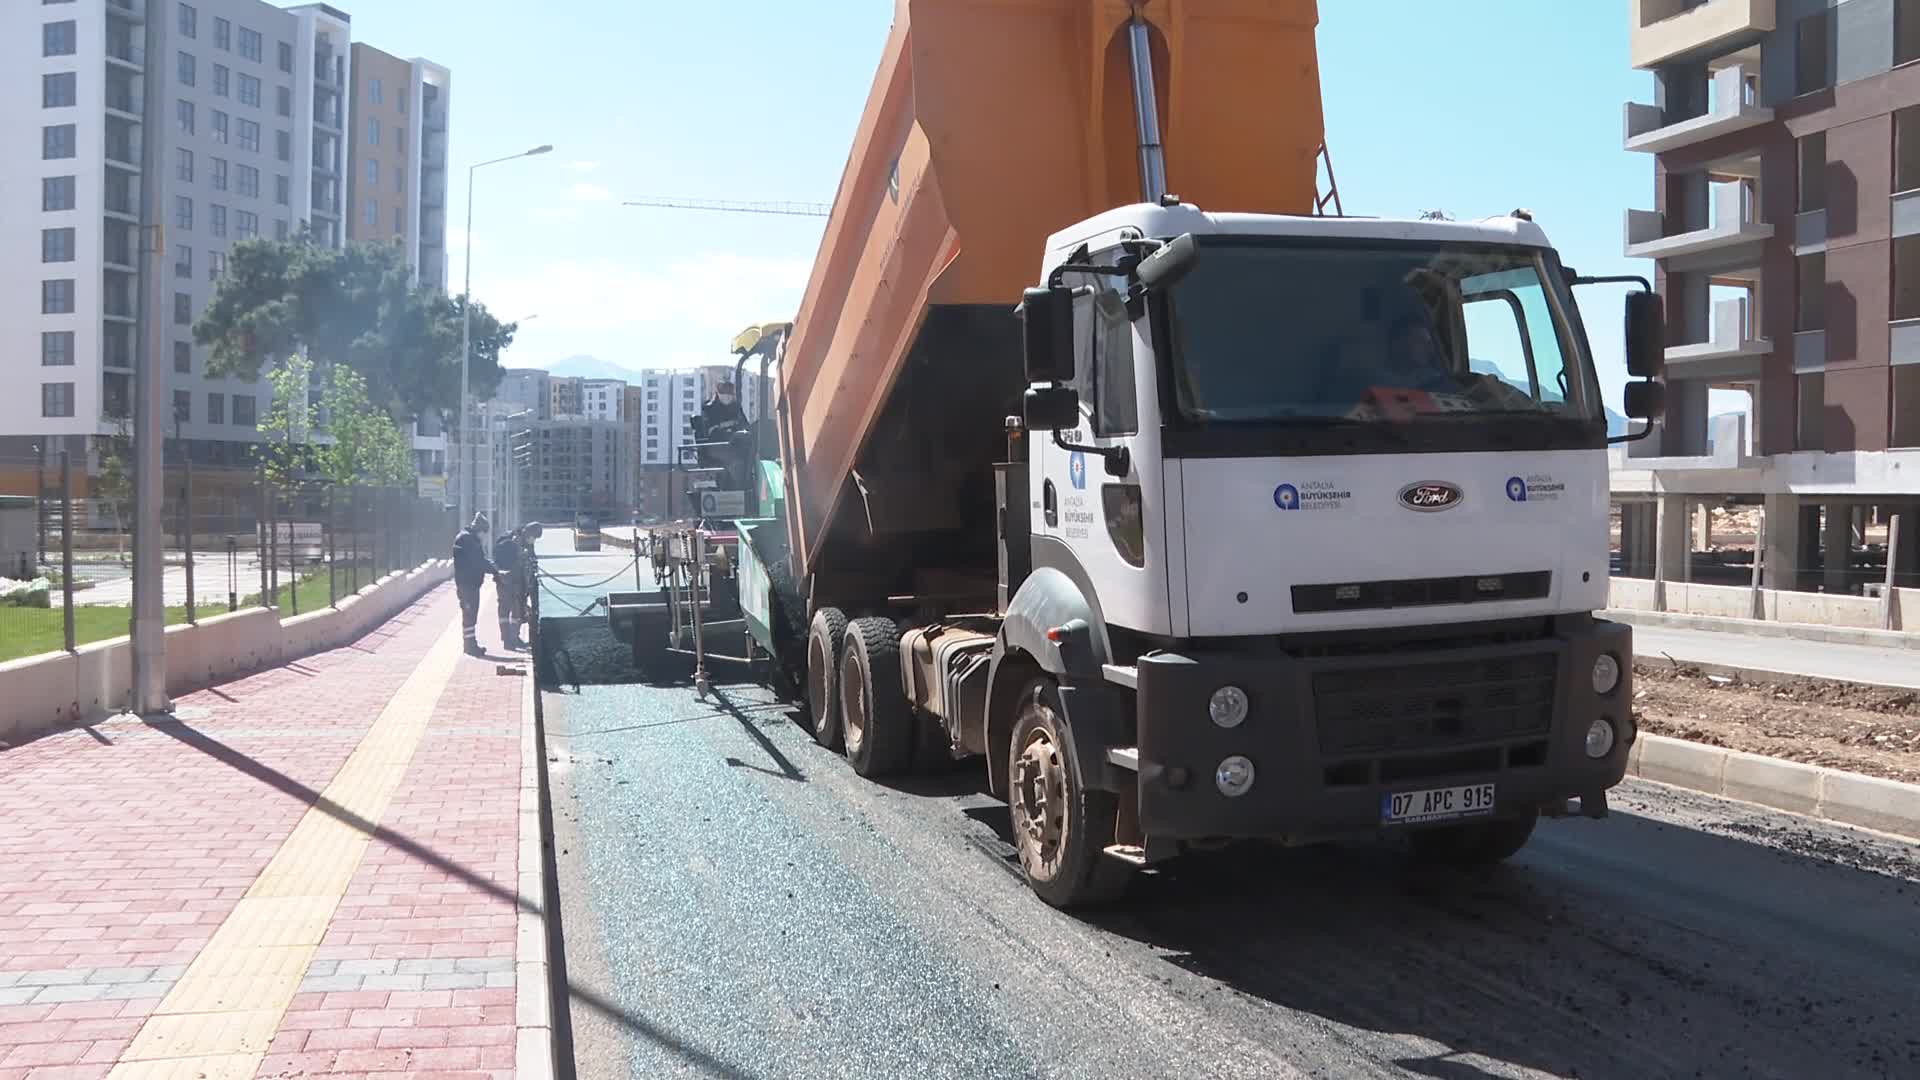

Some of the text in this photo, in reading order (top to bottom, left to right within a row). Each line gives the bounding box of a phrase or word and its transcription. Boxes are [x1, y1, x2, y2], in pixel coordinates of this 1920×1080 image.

[1413, 486, 1449, 504] Ford
[1392, 786, 1493, 816] 07 APC 915
